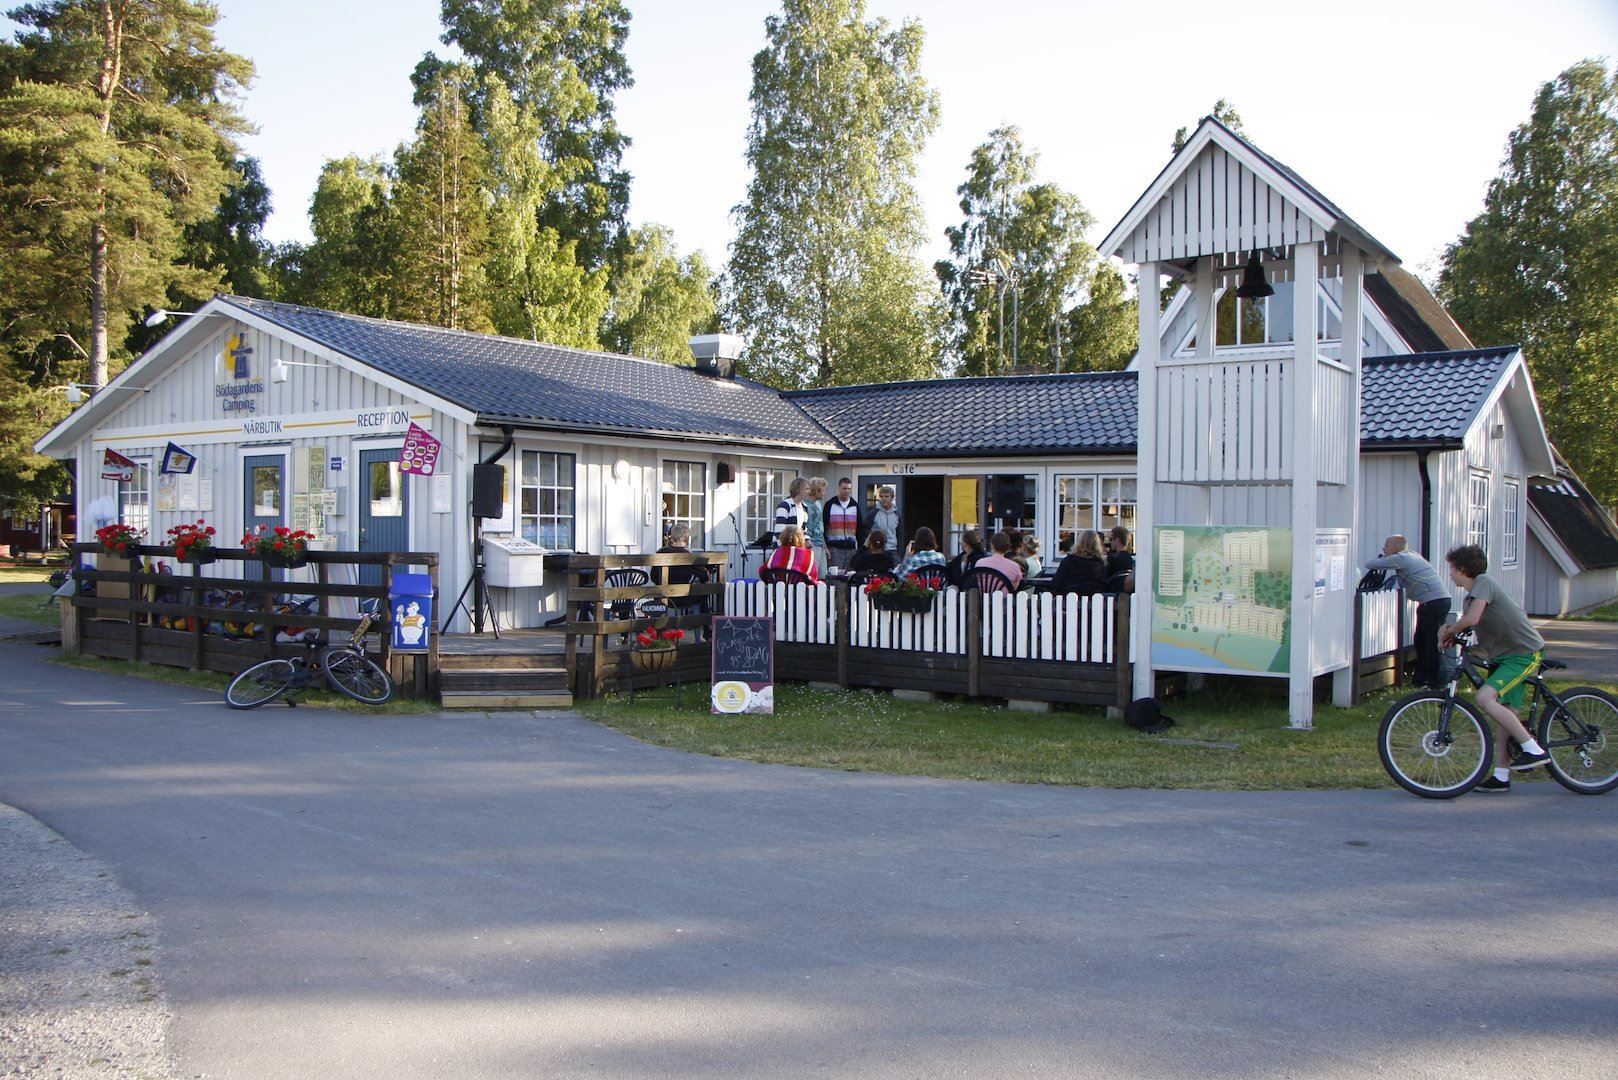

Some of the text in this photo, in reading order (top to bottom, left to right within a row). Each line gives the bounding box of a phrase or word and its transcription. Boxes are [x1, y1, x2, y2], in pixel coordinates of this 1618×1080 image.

[223, 399, 255, 413] Camping
[357, 410, 409, 428] RECEPTION
[244, 420, 282, 434] NÄRBUTIK
[892, 463, 915, 474] Café
